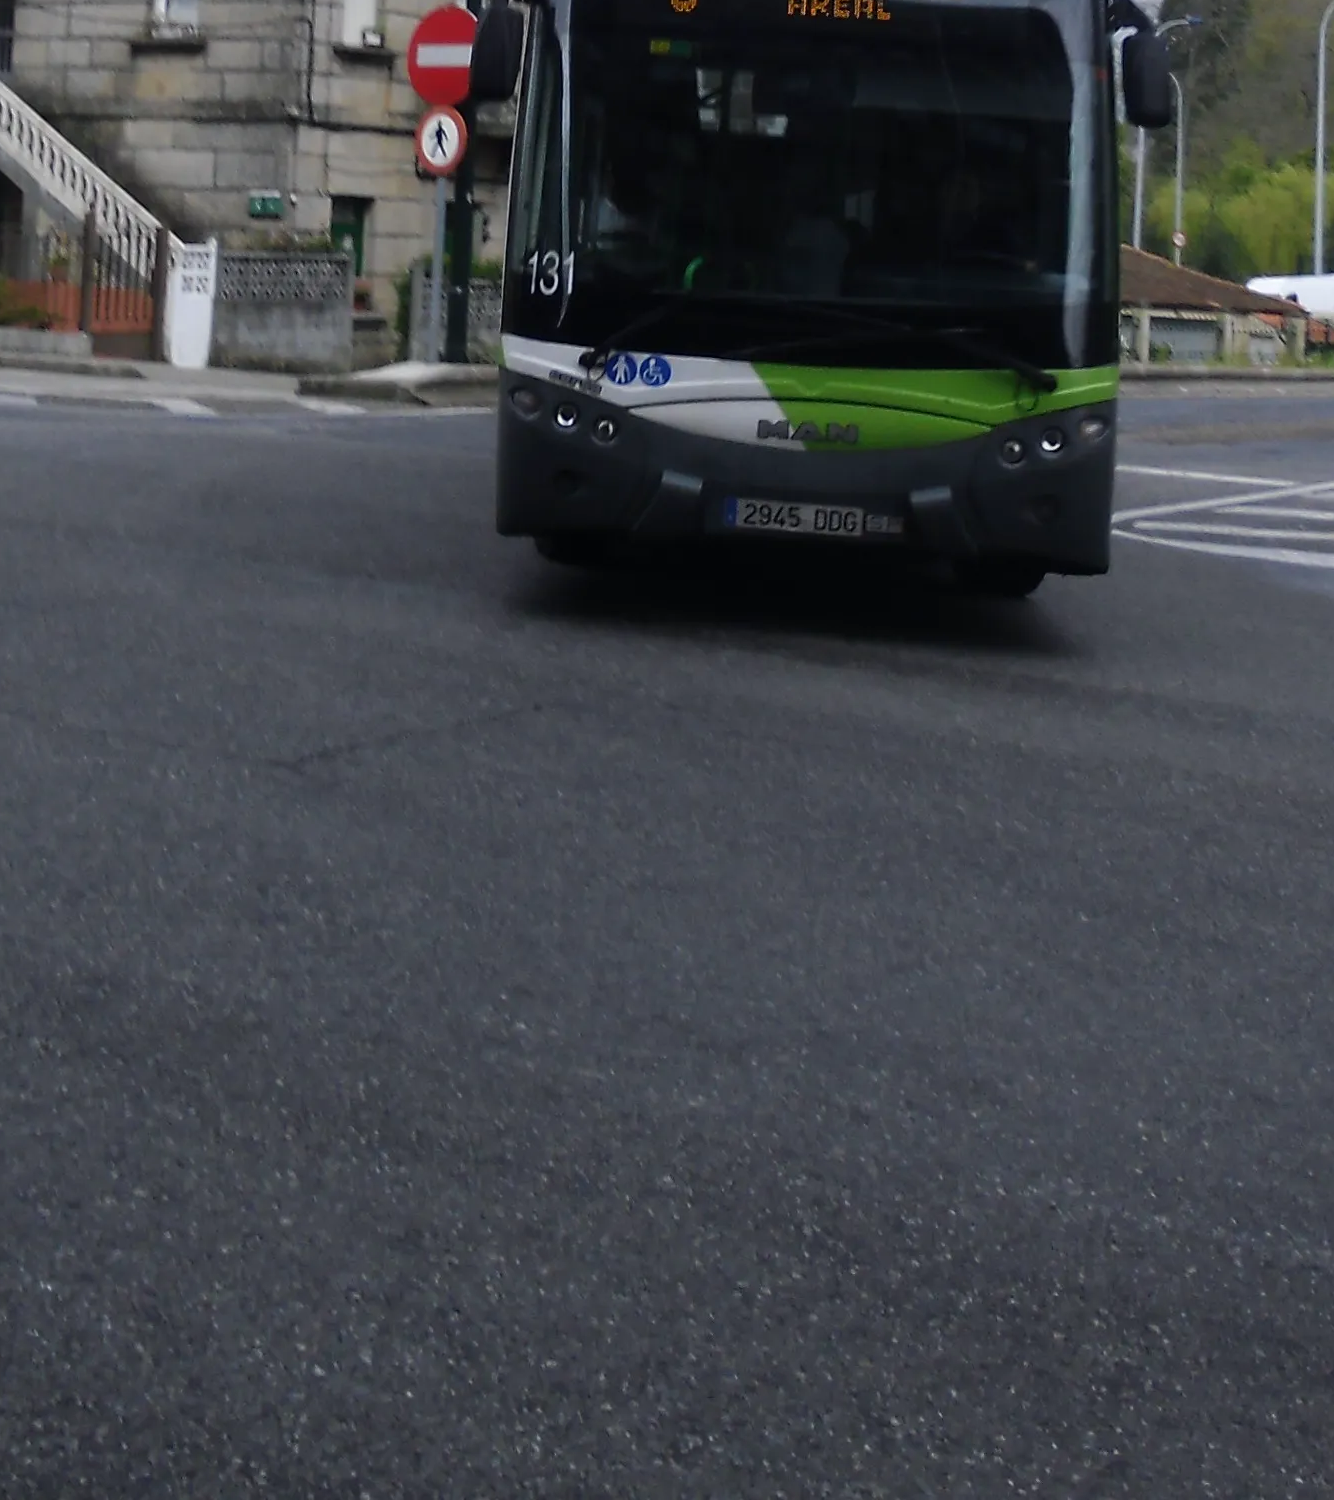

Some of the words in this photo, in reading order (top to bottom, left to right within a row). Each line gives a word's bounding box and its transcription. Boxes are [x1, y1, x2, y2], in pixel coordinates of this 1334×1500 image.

[528, 251, 574, 296] 131
[757, 419, 859, 444] MAN
[743, 503, 802, 528] 2945
[815, 509, 857, 533] DDG
